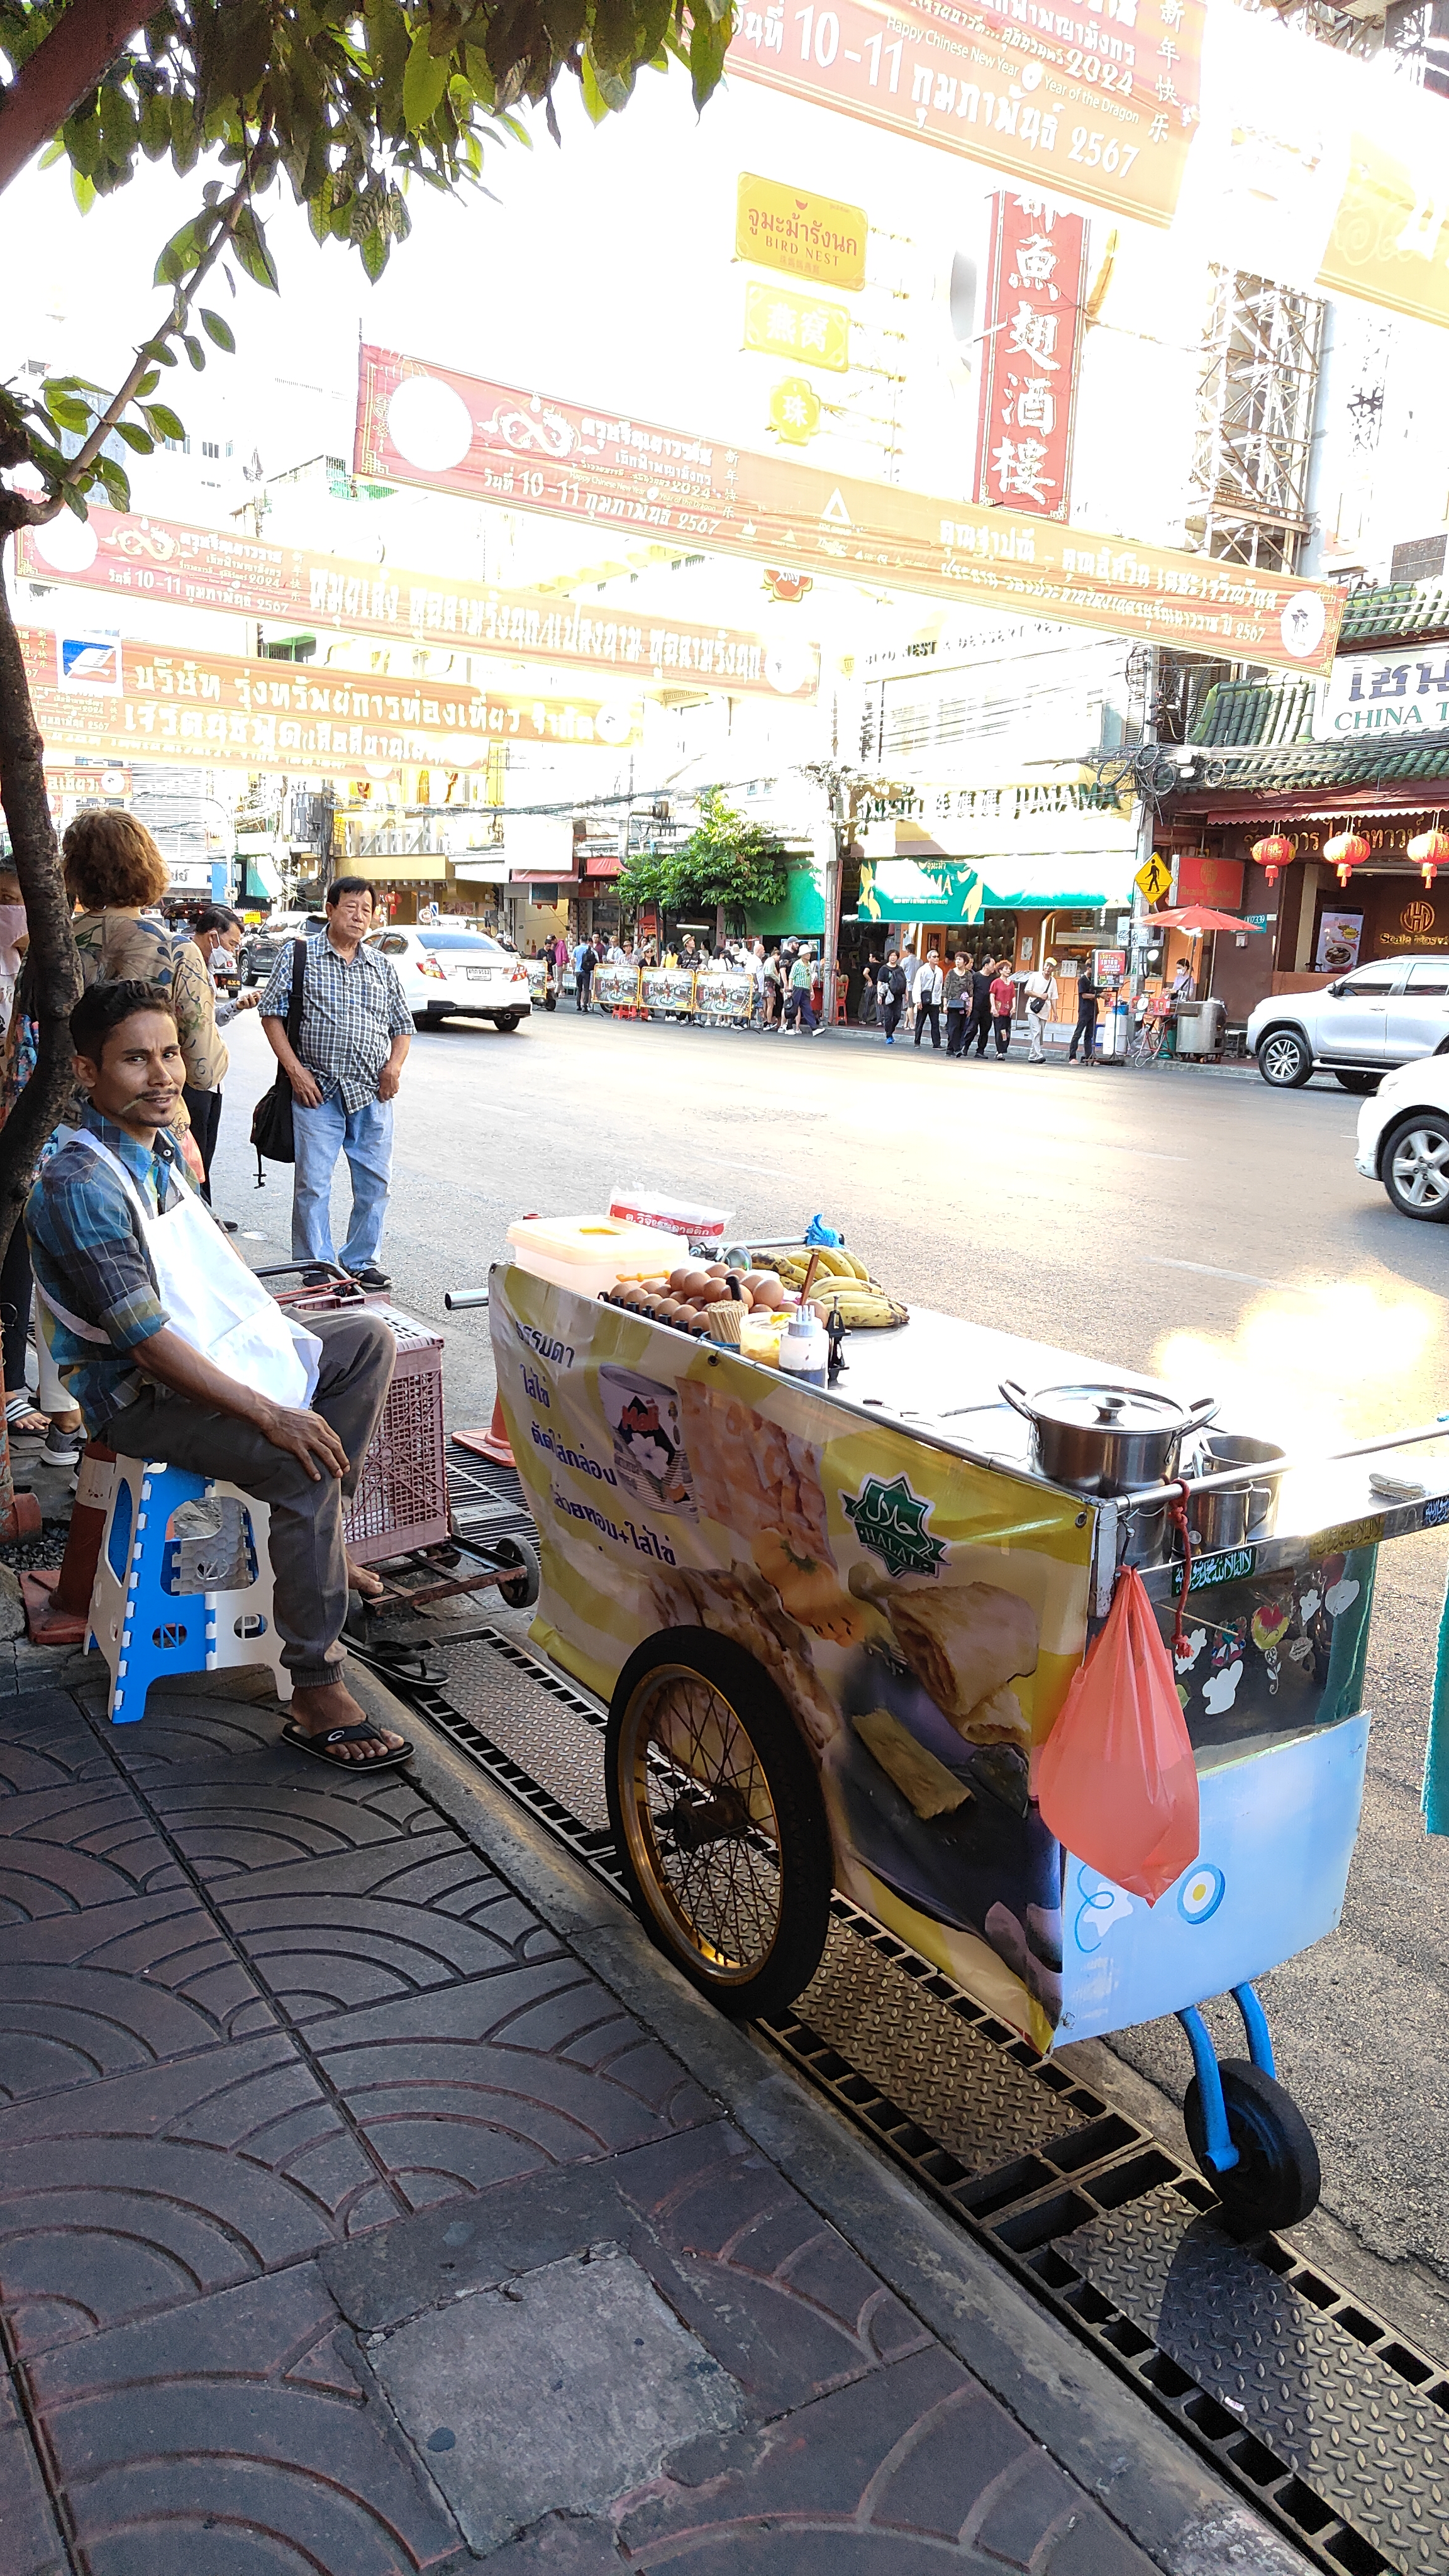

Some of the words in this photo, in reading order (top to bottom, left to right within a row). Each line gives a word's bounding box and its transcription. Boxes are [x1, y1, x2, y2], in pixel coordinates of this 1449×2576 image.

[886, 15, 924, 44] Happy
[924, 29, 969, 59] Chinese
[970, 45, 996, 69] New
[997, 55, 1019, 77] Year
[1045, 75, 1068, 97] Year
[1069, 86, 1082, 101] of
[1082, 91, 1100, 108] the
[1101, 99, 1139, 125] Dragon
[1065, 48, 1133, 97] 2024
[911, 63, 1065, 152] กุมภาพันธ์
[1067, 126, 1141, 179] 2567
[748, 208, 857, 257] จูมะม้ารังนก
[765, 235, 799, 255] BIRD
[806, 247, 840, 267] NEST
[991, 196, 1062, 506] 魚翅酒樓
[782, 394, 809, 428] 珠
[483, 467, 515, 494] วันที่
[584, 492, 672, 527] กุมภาพันธ์
[677, 513, 722, 536] 2567
[570, 470, 591, 484] Happy
[659, 492, 674, 503] Year
[692, 500, 716, 513] Dragon
[670, 480, 711, 500] 2024
[108, 568, 132, 589] วันที่
[186, 584, 252, 608] กุมภาพันธ์
[257, 598, 290, 614] 2567
[248, 574, 280, 589] 2024
[1233, 622, 1267, 643] 2567
[25, 668, 39, 679] 67
[134, 657, 221, 703] บริษัท
[87, 720, 111, 731] 2567
[1335, 704, 1423, 731] CHINA
[867, 1492, 918, 1537] حلال
[863, 1527, 917, 1568] HALAL
